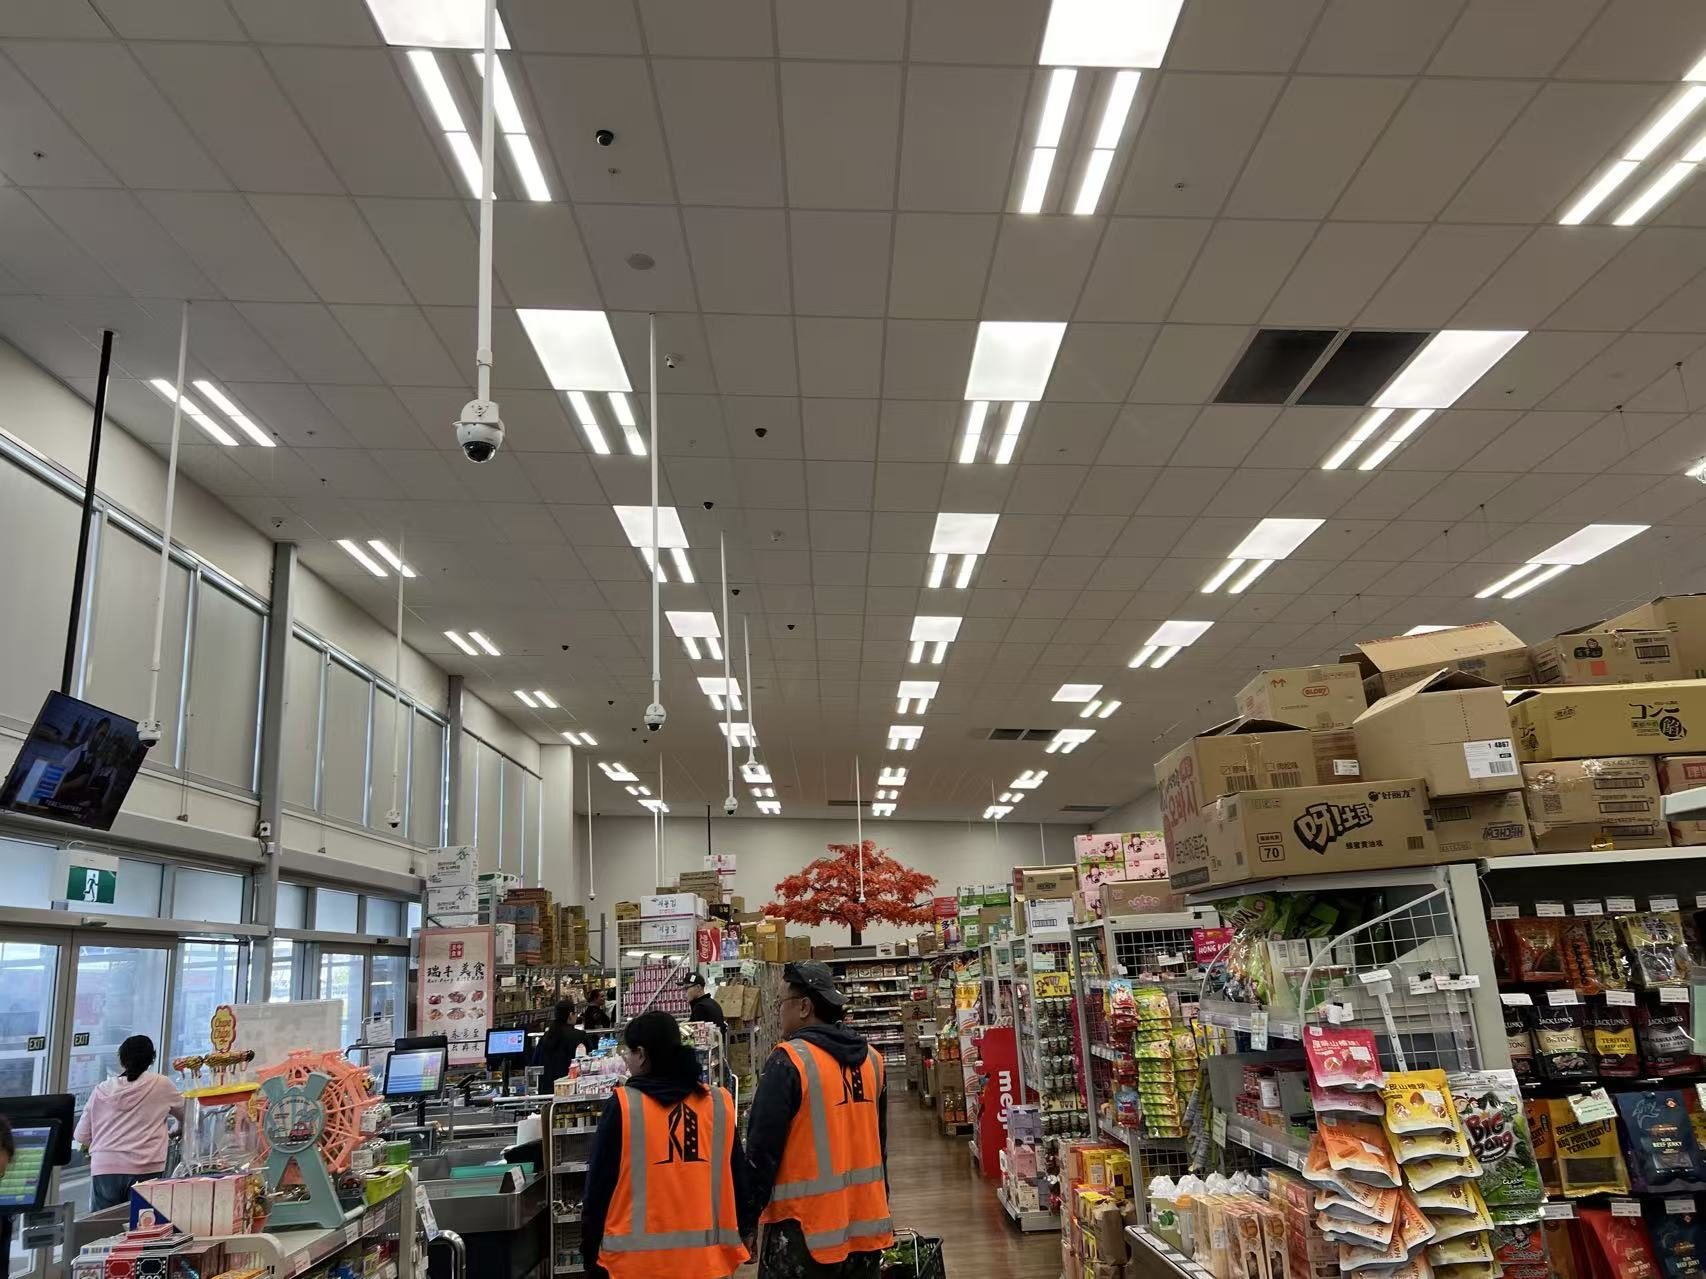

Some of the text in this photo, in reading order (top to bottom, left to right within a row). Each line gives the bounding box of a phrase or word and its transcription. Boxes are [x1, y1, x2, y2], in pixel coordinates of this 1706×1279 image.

[1264, 847, 1280, 859] 70
[29, 1039, 44, 1050] EXIT
[75, 1033, 89, 1045] EXIT
